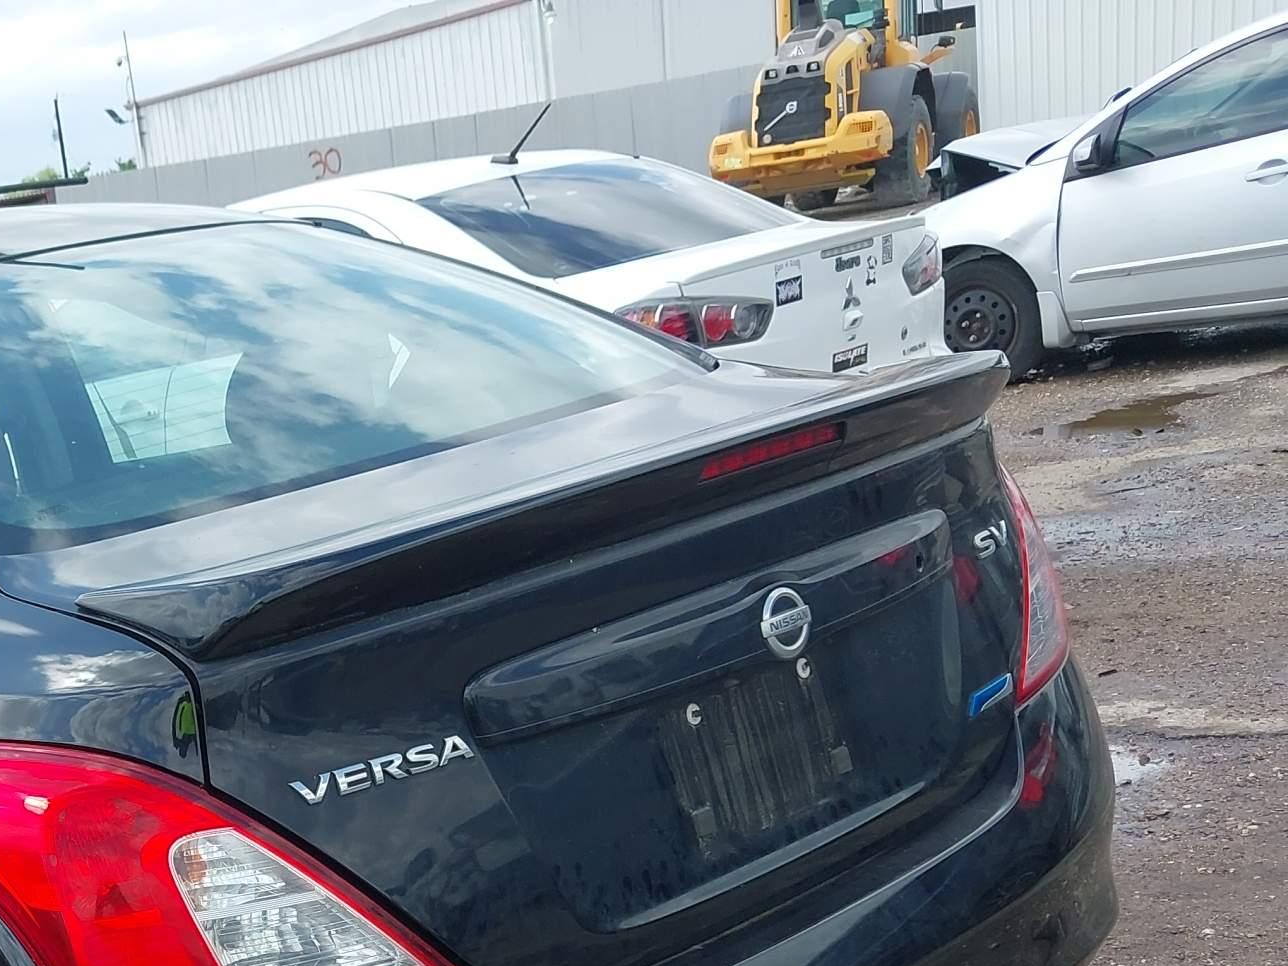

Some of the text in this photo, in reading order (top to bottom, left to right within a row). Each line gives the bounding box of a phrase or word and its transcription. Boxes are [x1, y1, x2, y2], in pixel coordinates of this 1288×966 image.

[308, 147, 341, 180] 30
[974, 519, 1007, 560] SV
[769, 609, 809, 633] NISSAN
[287, 734, 475, 805] VERSA
